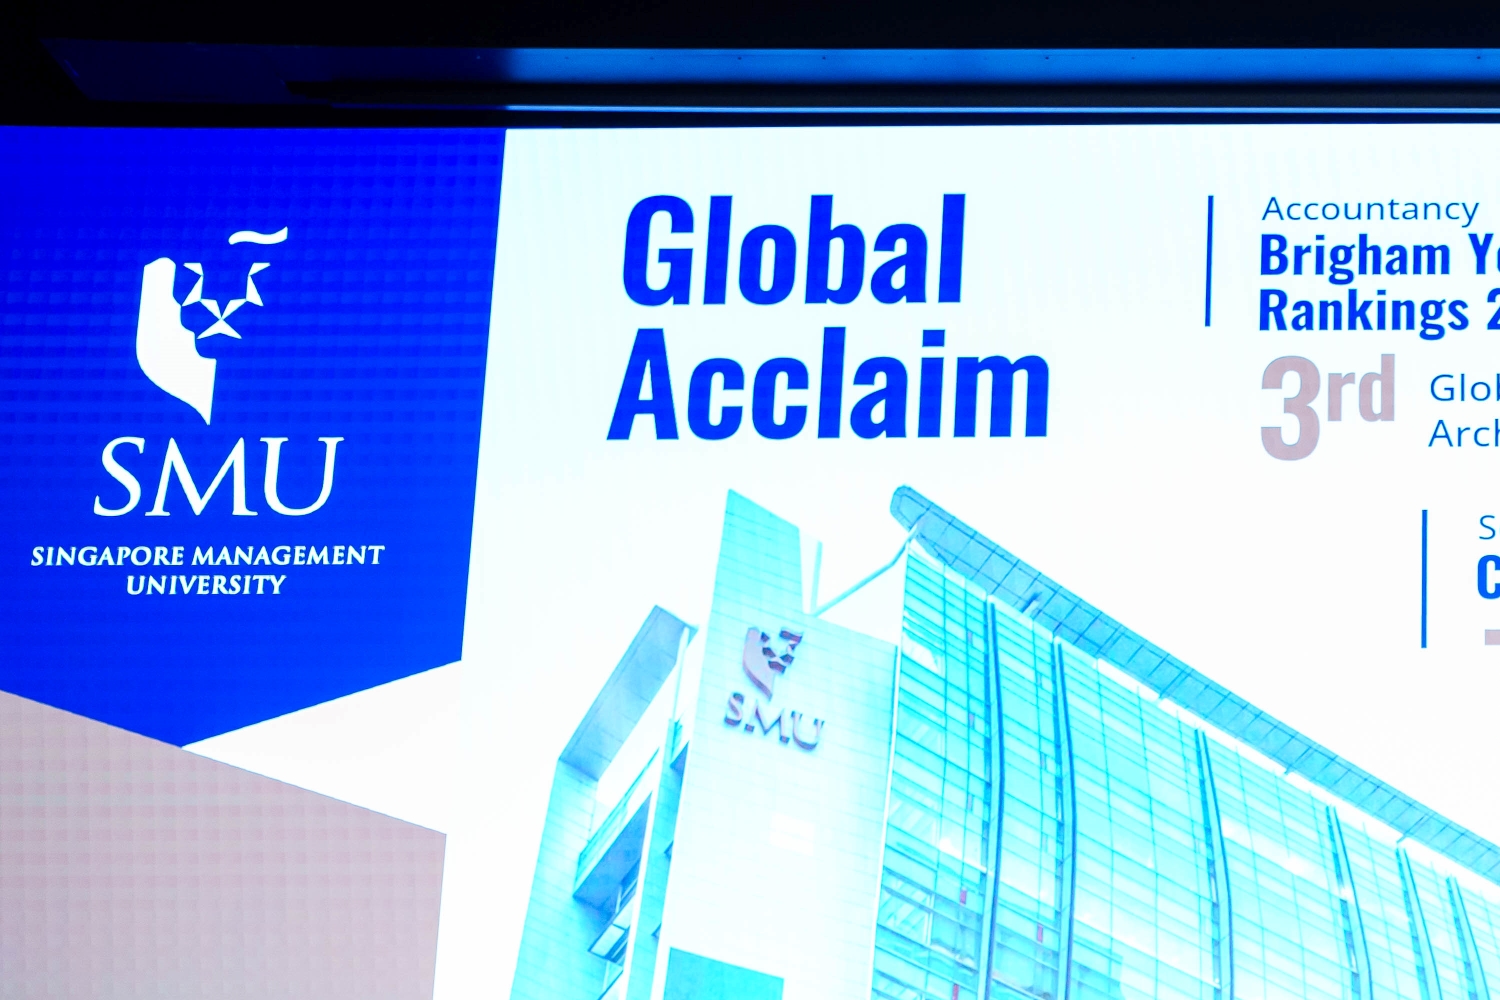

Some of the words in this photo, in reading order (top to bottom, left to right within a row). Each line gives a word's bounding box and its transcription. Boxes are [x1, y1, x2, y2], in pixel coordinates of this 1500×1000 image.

[1262, 197, 1479, 227] Accountancy
[622, 193, 965, 307] Global
[1260, 233, 1451, 284] Brigham
[1259, 287, 1469, 341] Rankings
[606, 327, 1049, 441] Acclaim
[1260, 353, 1395, 461] 3rd
[94, 436, 344, 516] SMU
[31, 546, 184, 566] SINGAPORE
[191, 545, 384, 565] MANAGEMENT
[127, 575, 286, 595] UNIVERSITY
